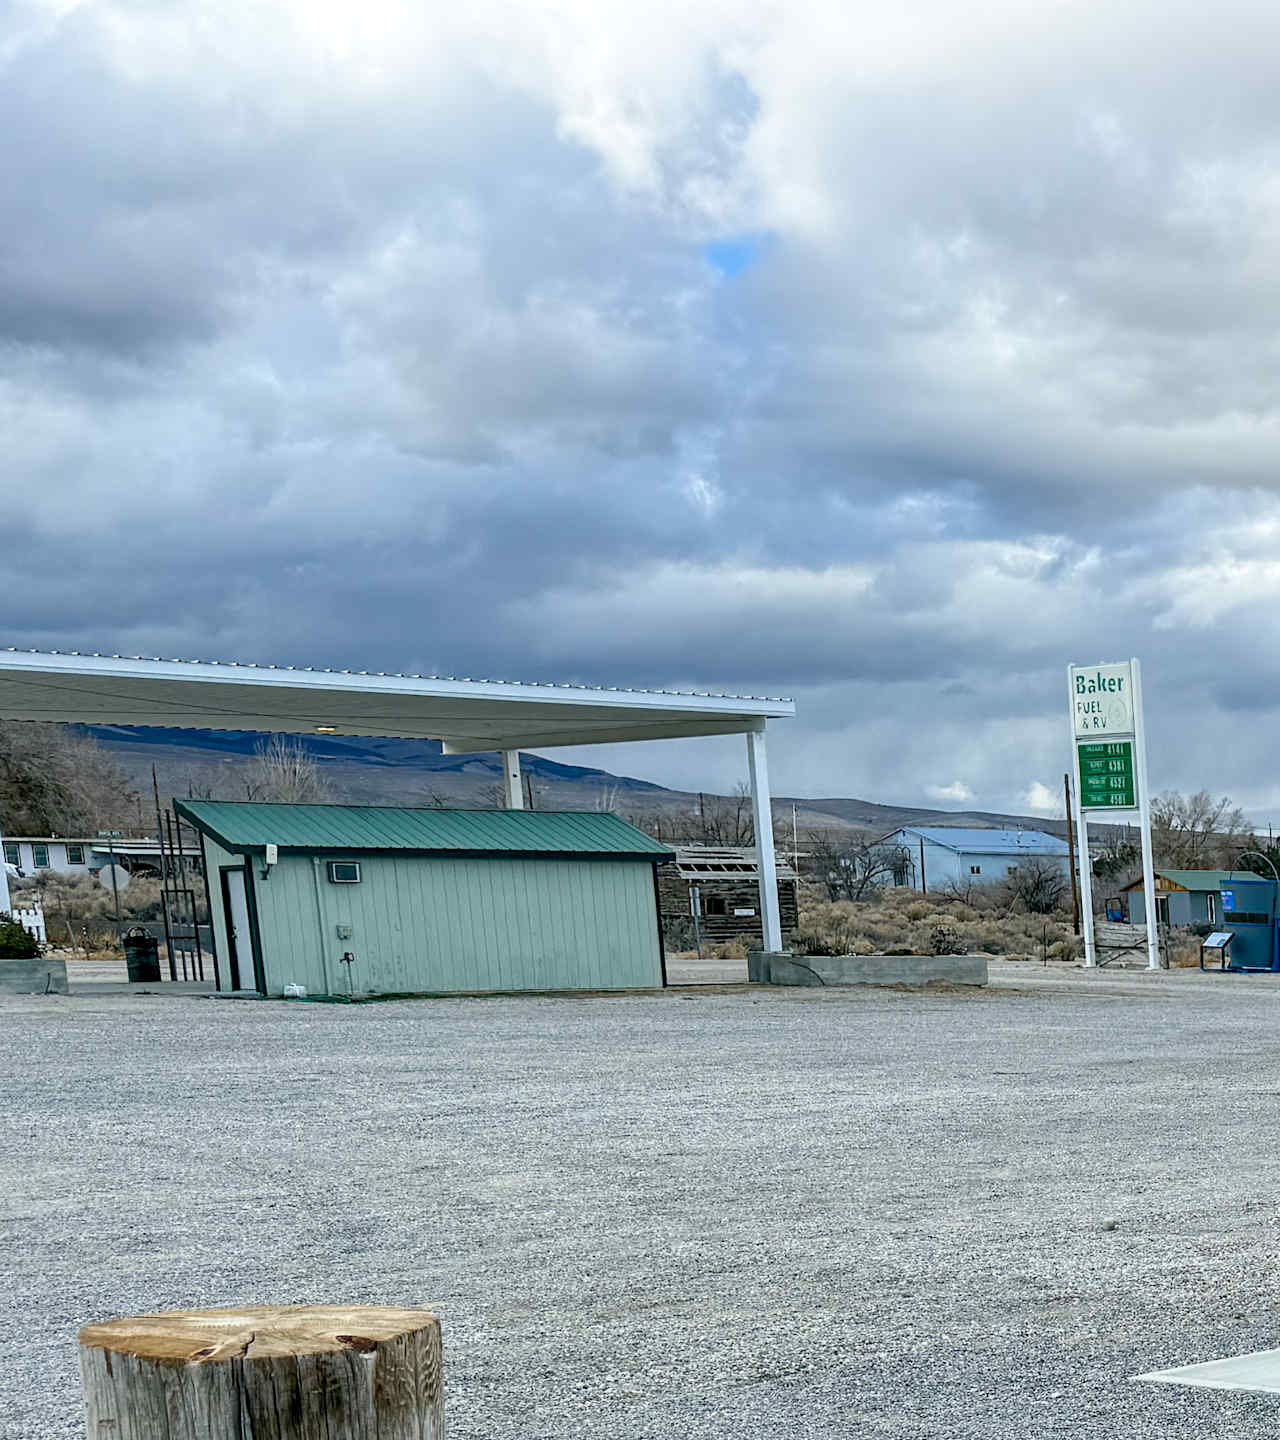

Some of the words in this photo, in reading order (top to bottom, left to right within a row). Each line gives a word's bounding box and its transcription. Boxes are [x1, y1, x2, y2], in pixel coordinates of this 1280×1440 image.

[1076, 672, 1124, 694] Baker
[1077, 701, 1102, 714] FUEL
[1082, 718, 1089, 729] &
[1093, 716, 1107, 729] RV
